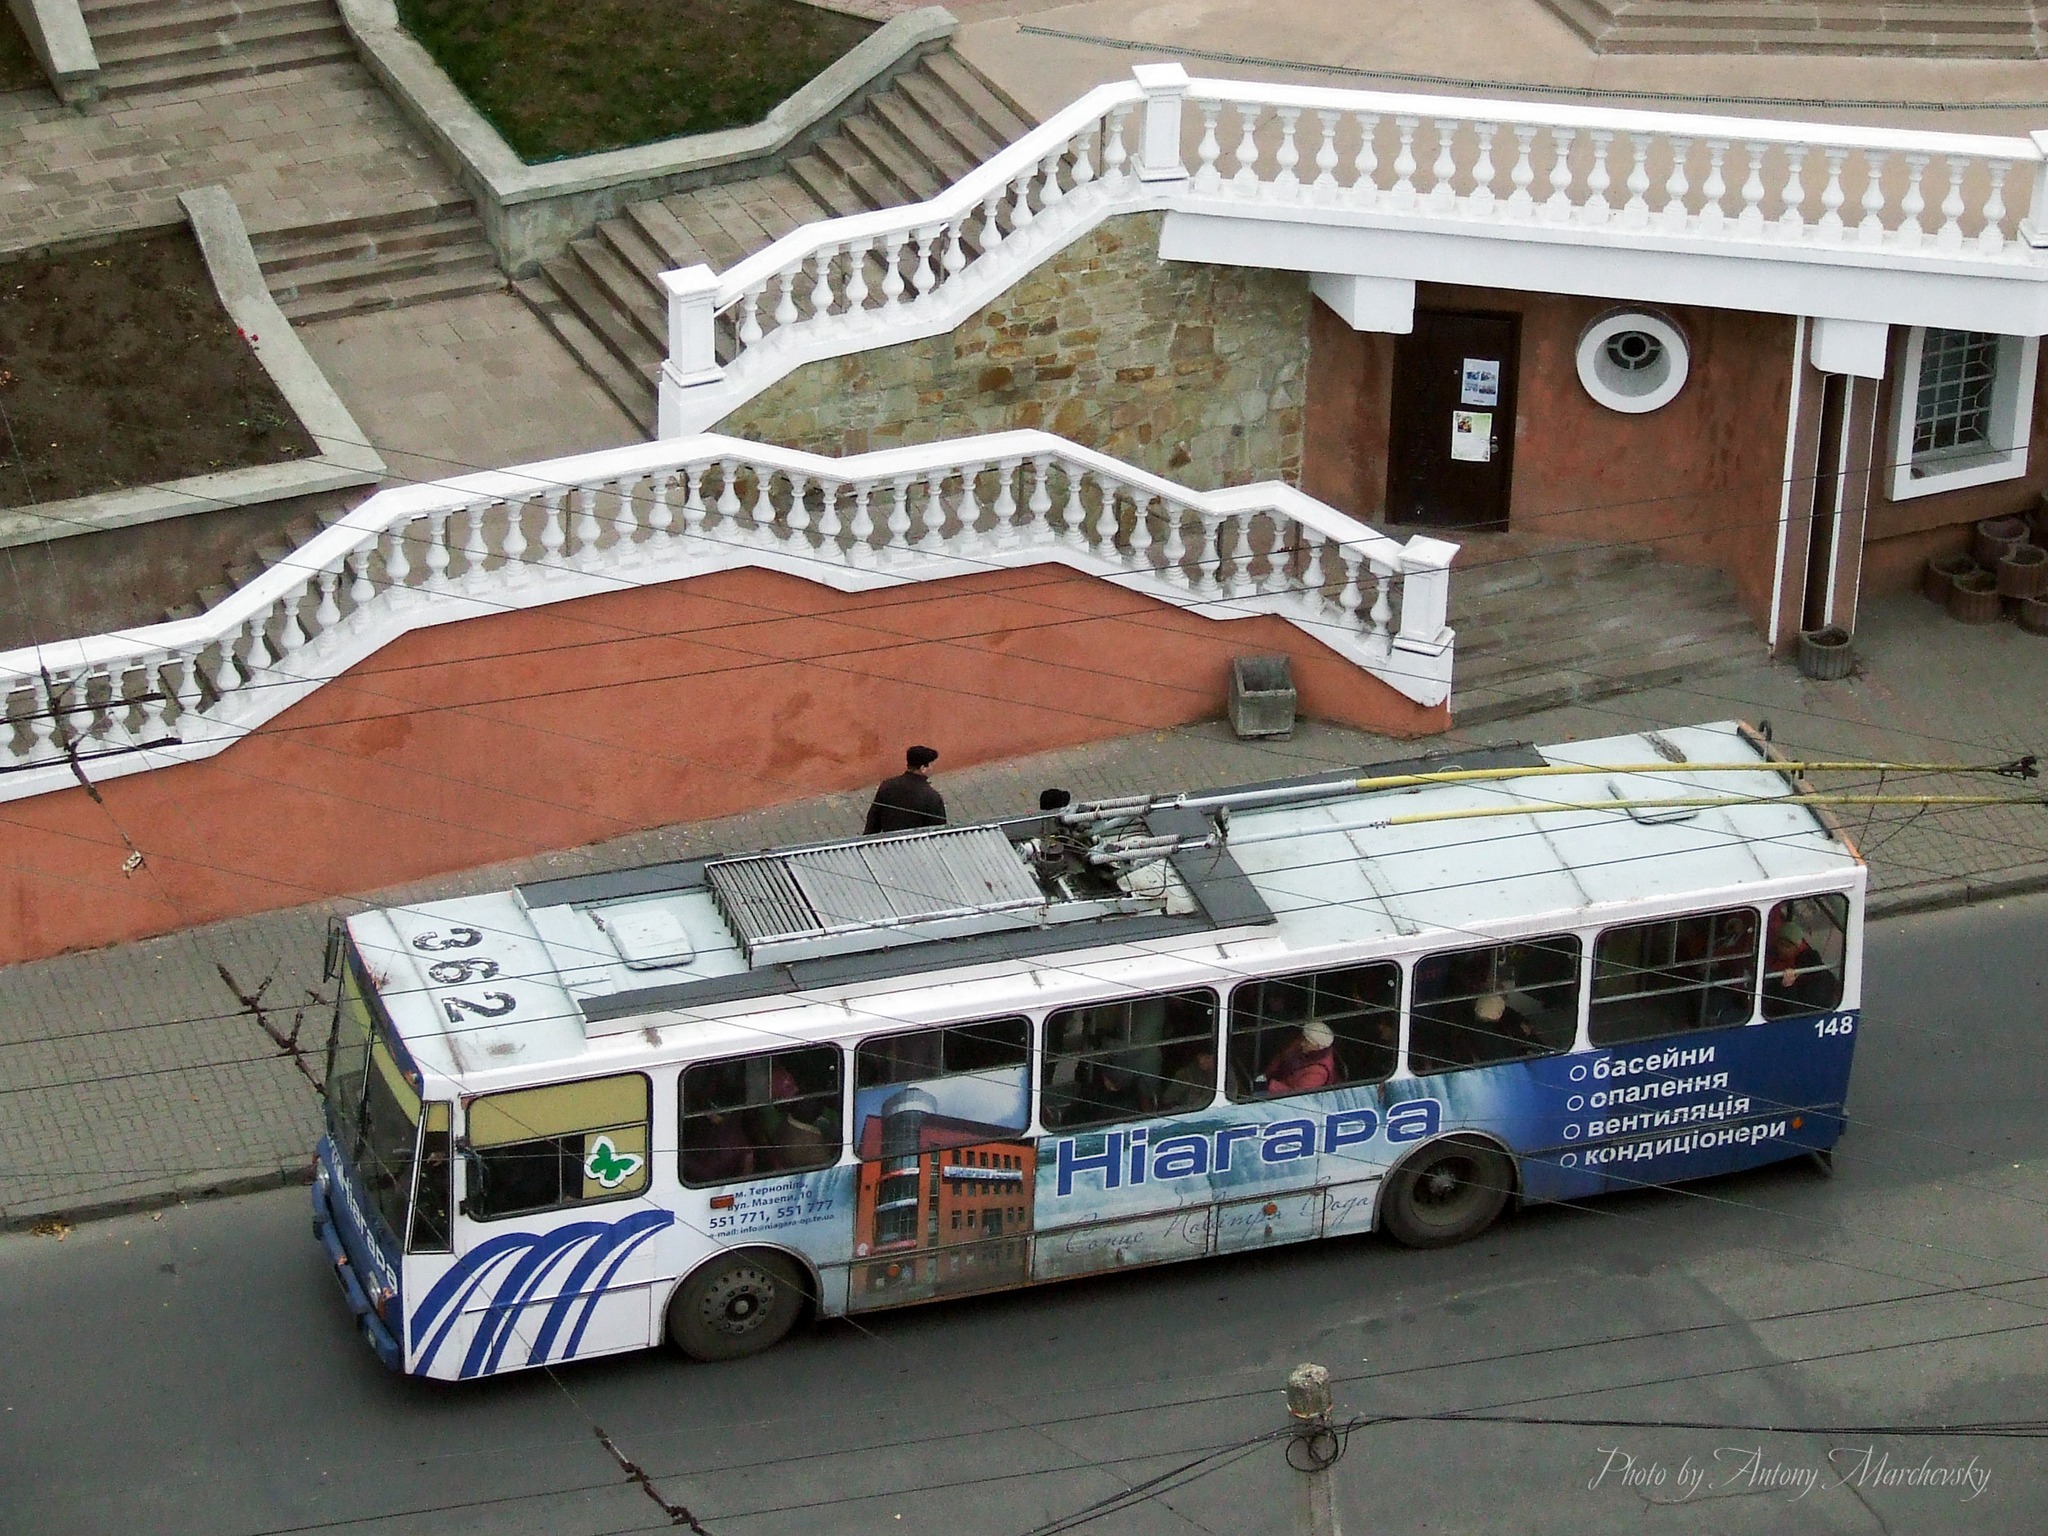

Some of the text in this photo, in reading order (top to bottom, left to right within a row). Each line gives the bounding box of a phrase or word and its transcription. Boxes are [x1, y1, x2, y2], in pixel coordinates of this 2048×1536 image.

[1814, 1016, 1853, 1038] 148
[1592, 1046, 1716, 1081] басейни
[1589, 1071, 1729, 1109] опалення
[1587, 1095, 1751, 1138] вентиляція
[1584, 1119, 1787, 1166] кондиціонери
[800, 1190, 813, 1200] 10
[709, 1199, 834, 1229] 551 771, 551 777
